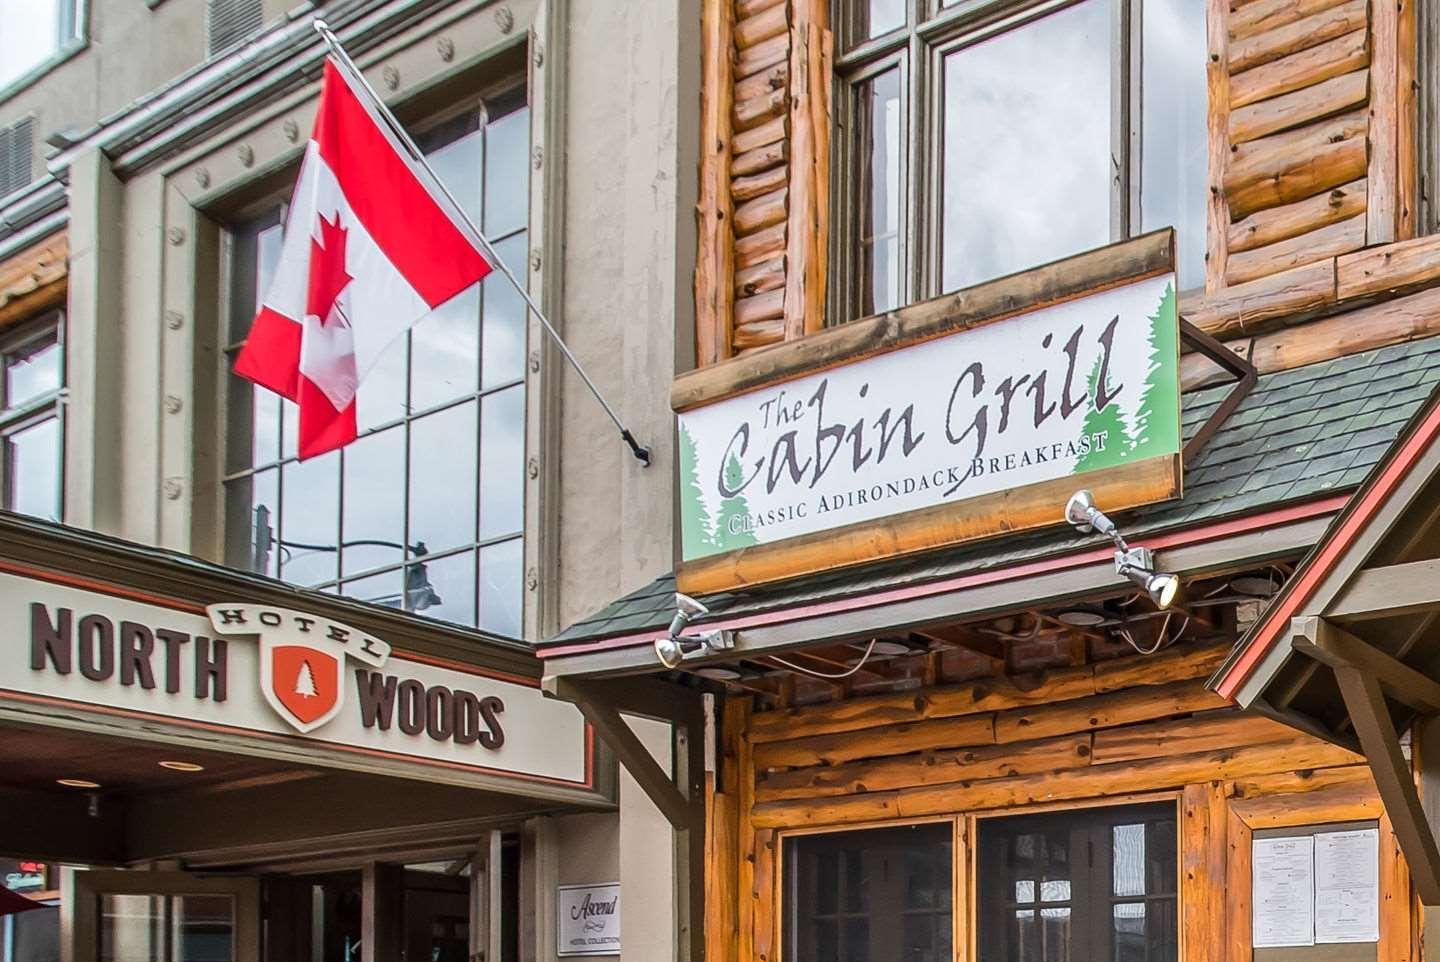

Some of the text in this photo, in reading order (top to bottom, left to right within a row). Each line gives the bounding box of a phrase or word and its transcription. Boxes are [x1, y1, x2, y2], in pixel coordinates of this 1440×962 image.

[717, 315, 1123, 499] Cabin Grill
[760, 391, 803, 430] The
[728, 430, 1110, 535] CLASSIC ADIRONDACK BREAKFAST
[217, 609, 382, 659] HOTEL
[30, 602, 505, 750] NORTH WOODS
[571, 893, 618, 920] Ascend
